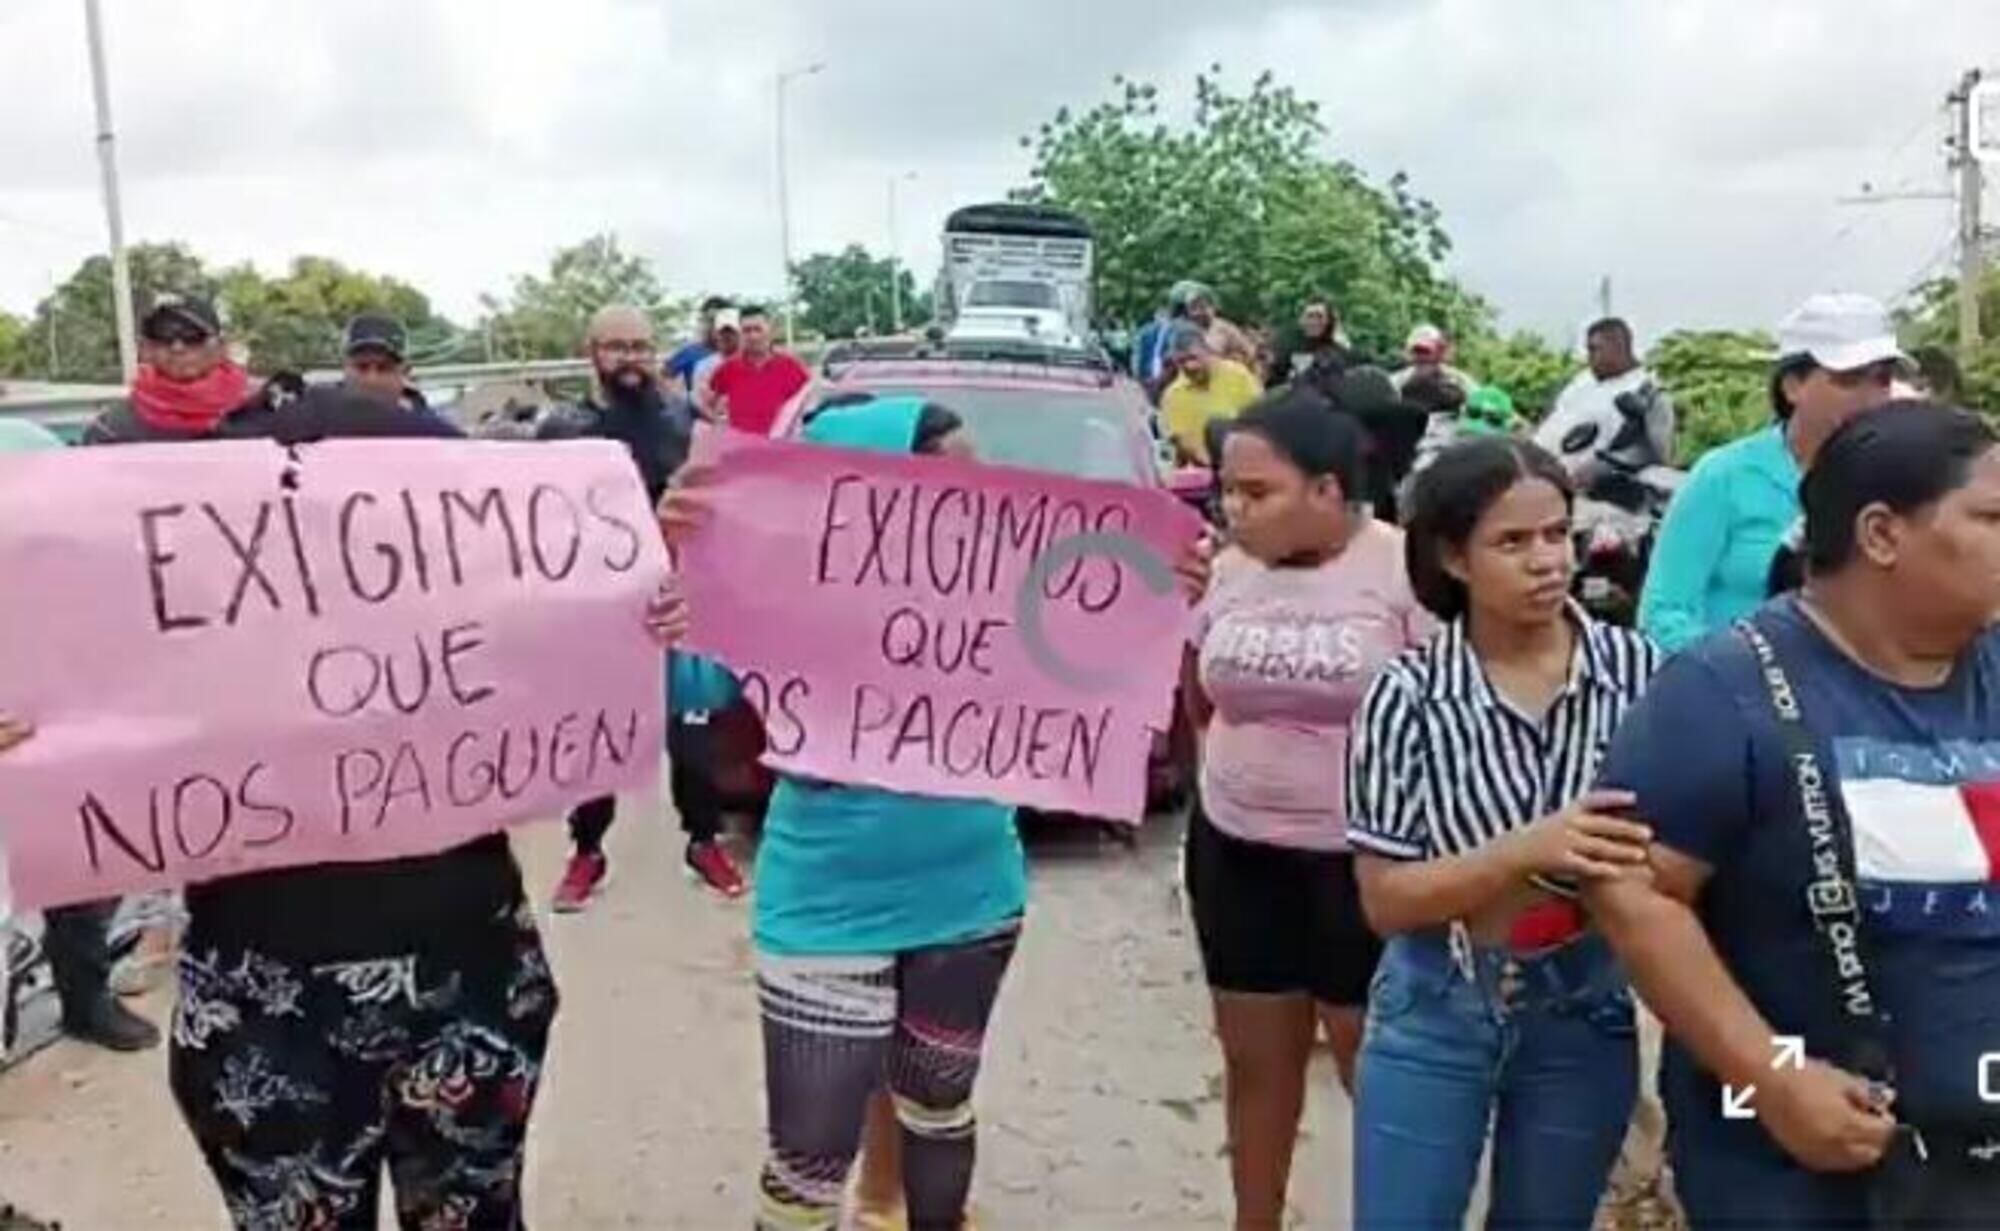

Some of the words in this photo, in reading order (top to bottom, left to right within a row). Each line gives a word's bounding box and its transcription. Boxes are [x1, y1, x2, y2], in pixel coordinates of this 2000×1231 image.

[139, 483, 641, 633] EXIGIMOS
[816, 474, 1131, 614] EXIGIMOS
[307, 622, 496, 718] QUE
[882, 605, 1011, 675] QUE
[738, 669, 811, 756] OS
[78, 762, 295, 873] NOS
[335, 707, 638, 836] PAGUEN
